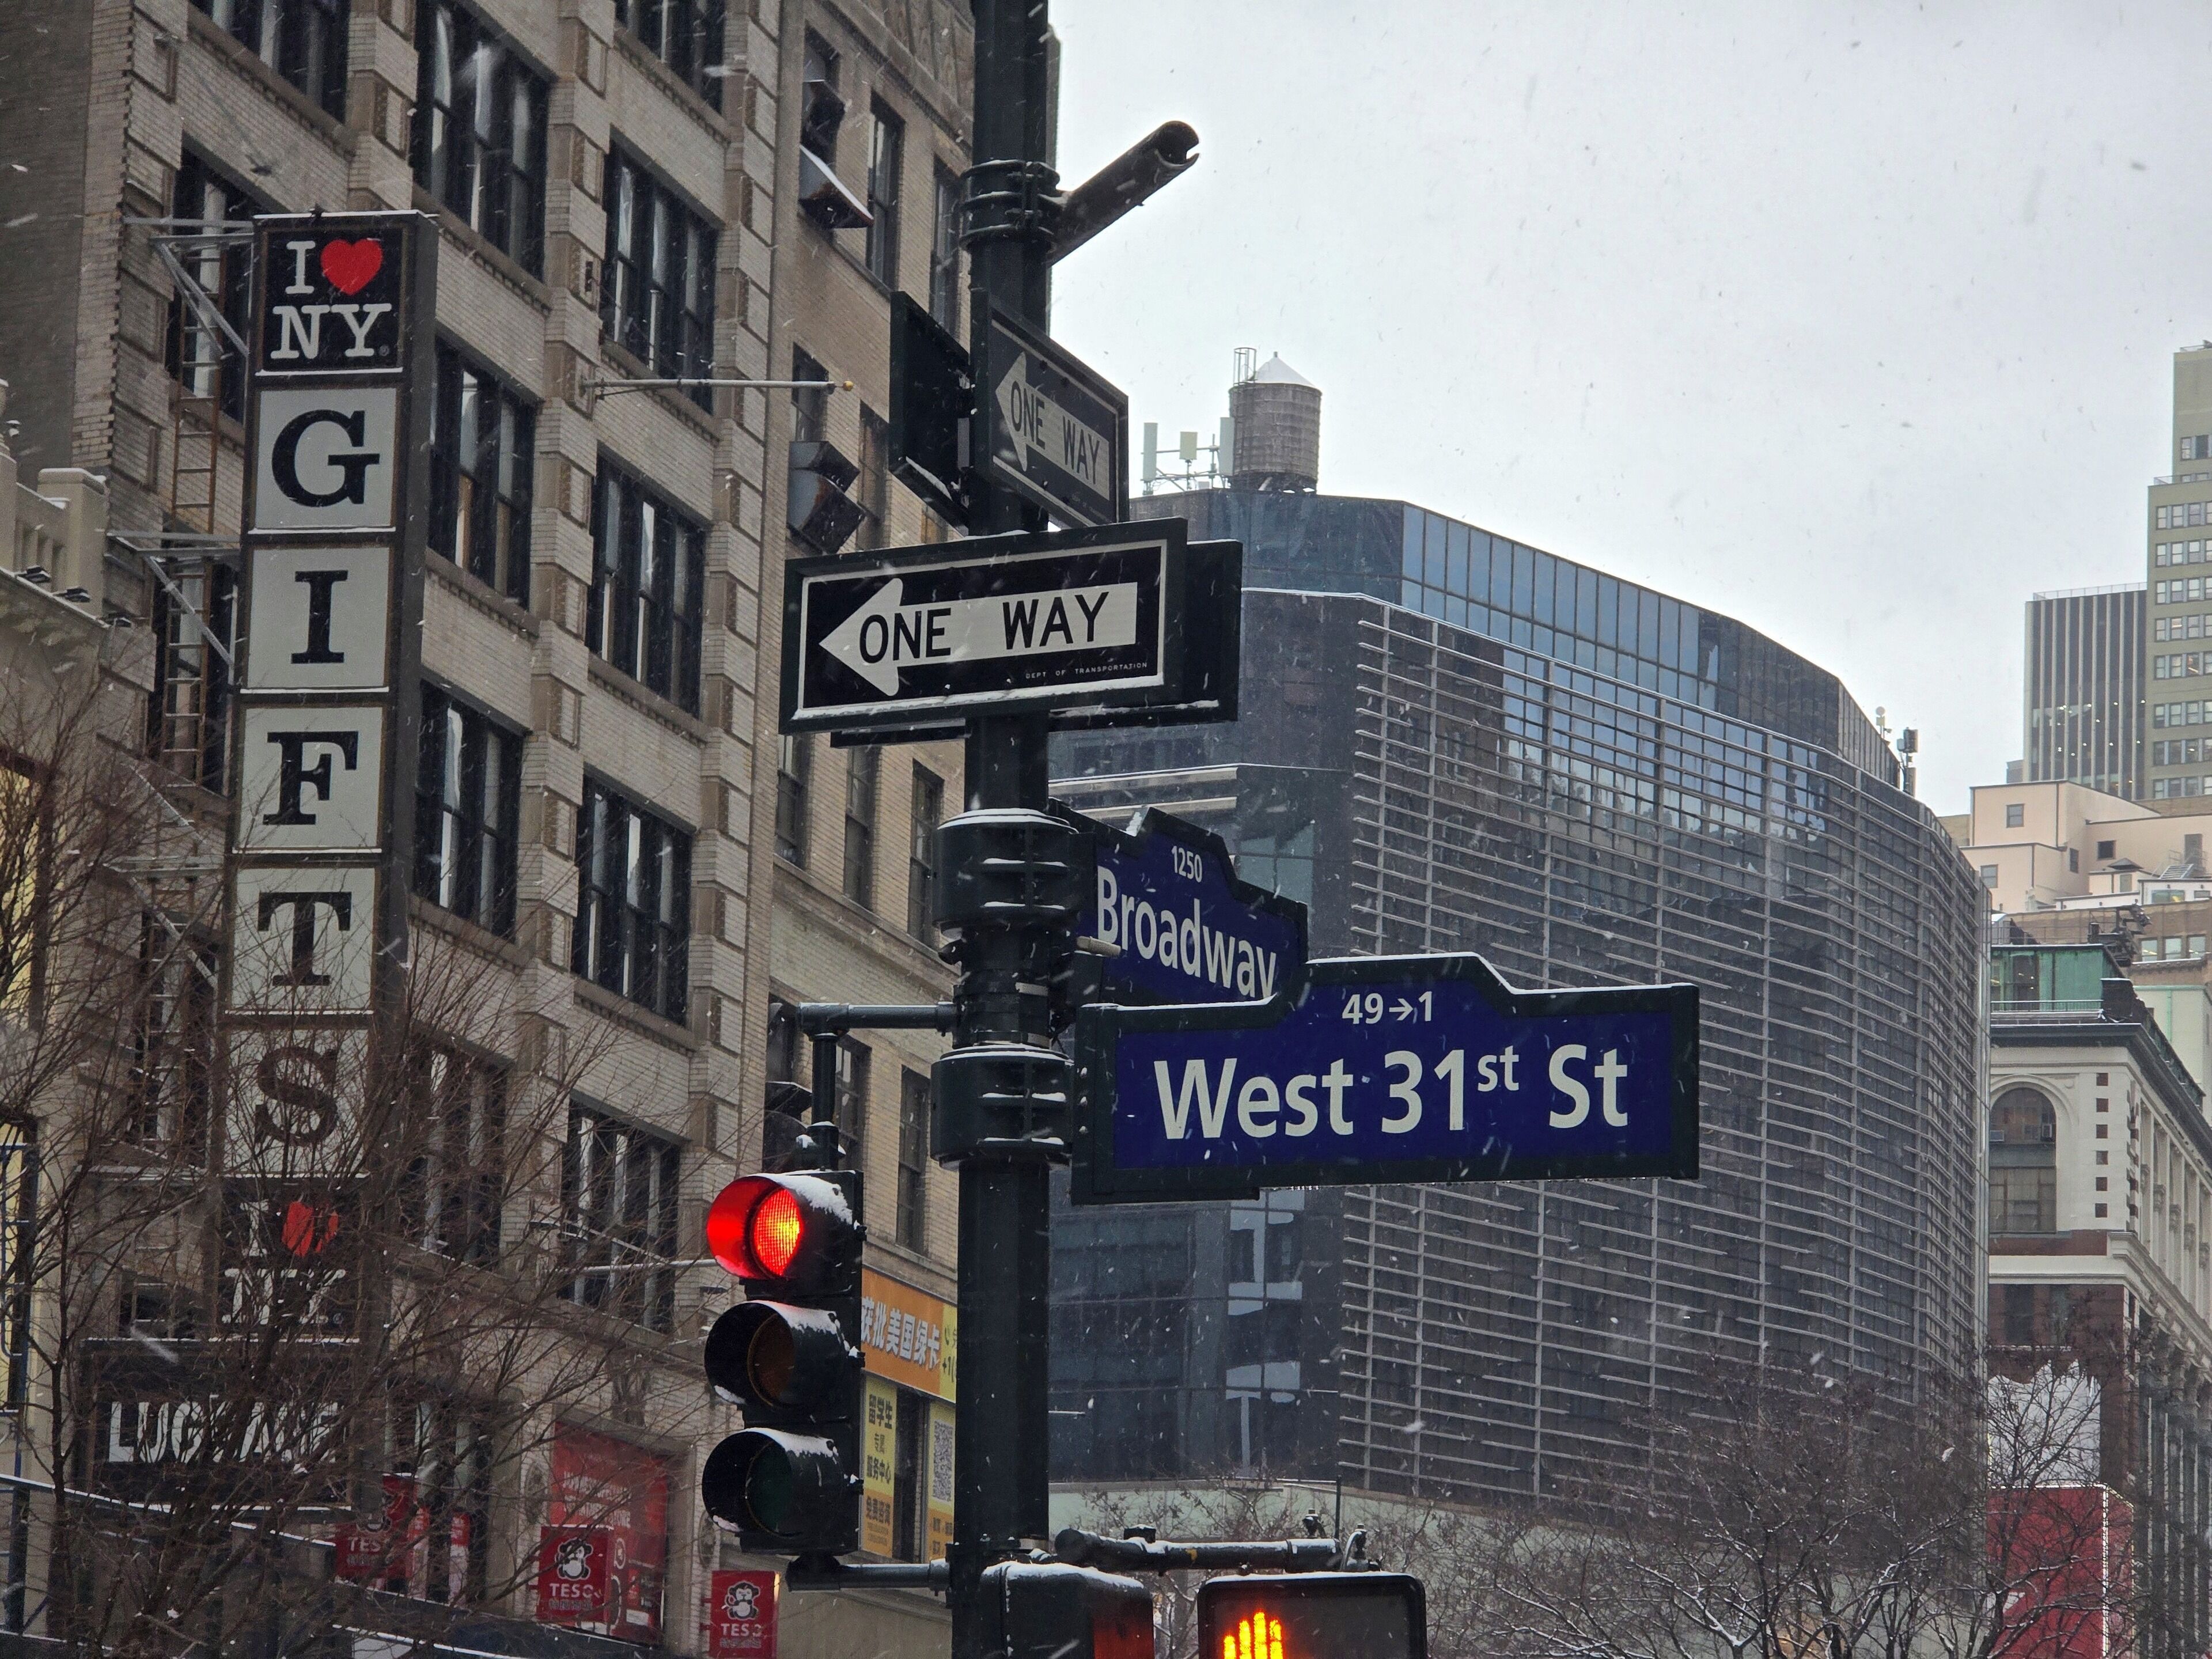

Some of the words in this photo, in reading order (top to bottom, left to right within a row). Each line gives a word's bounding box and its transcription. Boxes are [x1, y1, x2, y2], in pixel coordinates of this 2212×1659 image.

[285, 241, 316, 294] I
[271, 303, 392, 359] NY
[1011, 381, 1046, 450] ONE
[1063, 416, 1100, 484] WAY
[860, 608, 951, 663] ONE
[1003, 591, 1109, 649] WAY
[1075, 662, 1148, 675] TRANSPORTATION
[1171, 845, 1203, 882] 1250
[1097, 866, 1277, 999] Broadway
[1154, 1058, 1354, 1139] West
[1381, 1046, 1519, 1134] 31st
[1549, 1044, 1628, 1128] St
[869, 1394, 892, 1429] 留学生
[866, 1455, 891, 1484] 服务中心
[347, 1536, 392, 1552] TES
